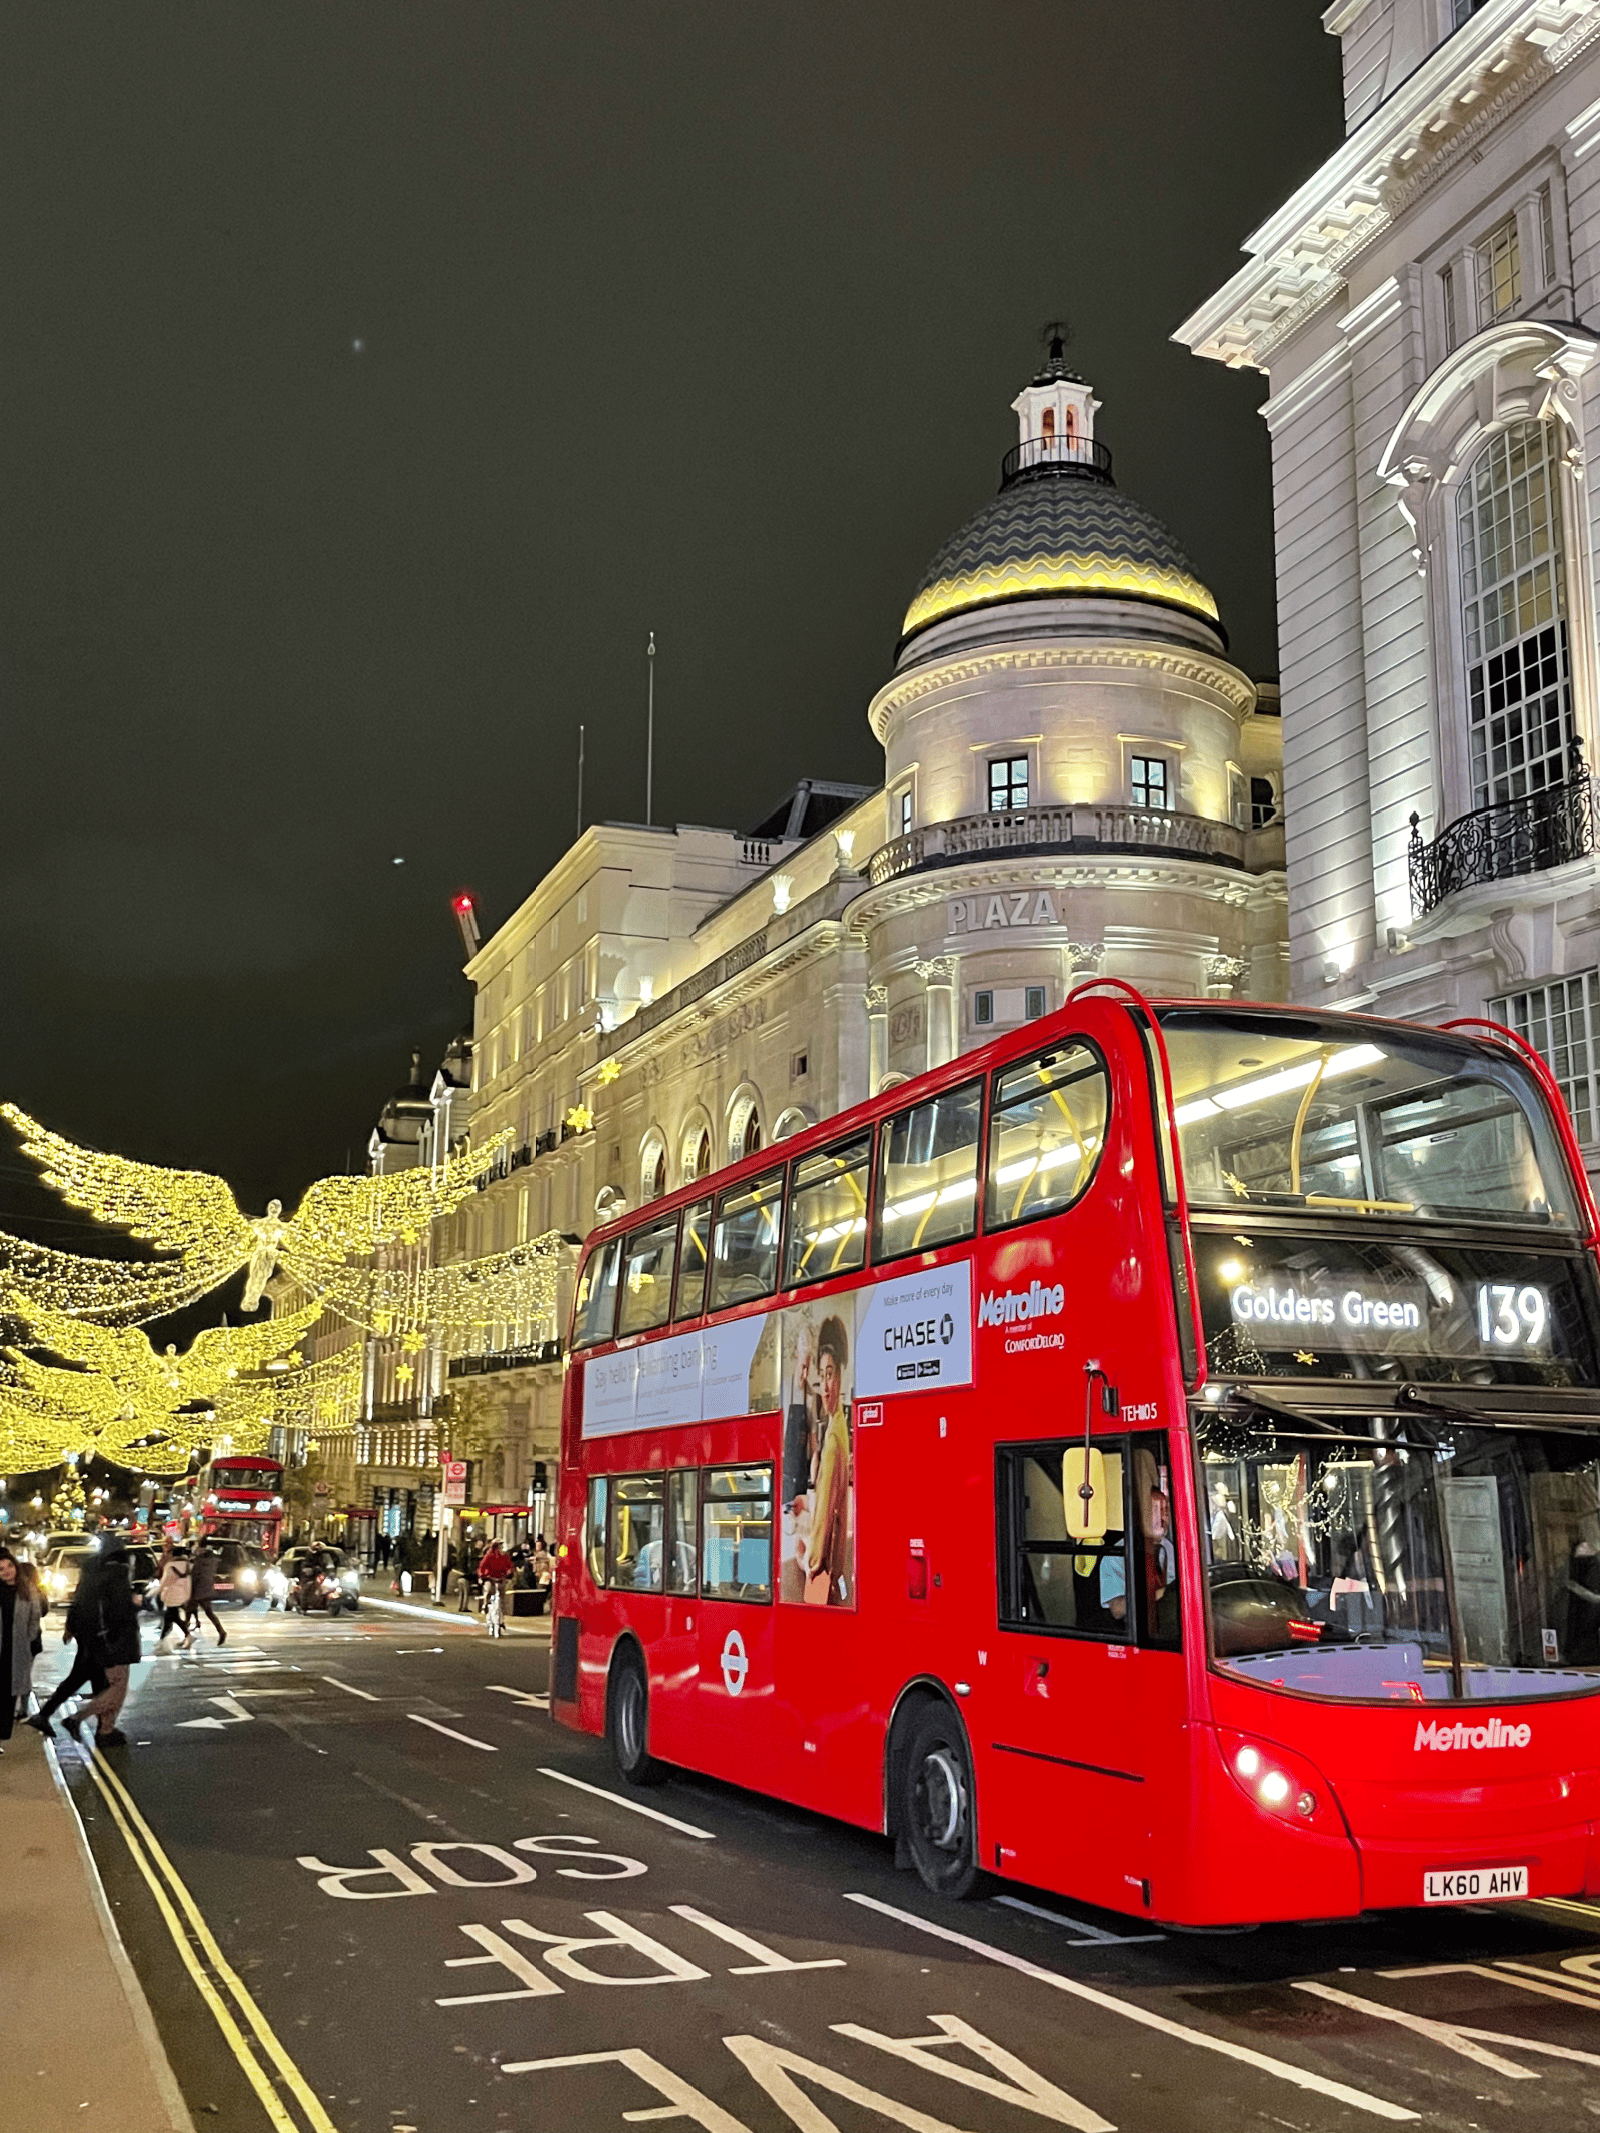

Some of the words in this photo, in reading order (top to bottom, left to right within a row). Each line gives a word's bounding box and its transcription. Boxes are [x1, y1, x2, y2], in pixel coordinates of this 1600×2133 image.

[948, 890, 1058, 935] PLAZA
[900, 1292, 915, 1304] more
[916, 1287, 922, 1300] of
[923, 1286, 940, 1299] every
[942, 1282, 953, 1296] day
[977, 1280, 1065, 1328] Metroline
[1232, 1286, 1335, 1323] Golders
[1343, 1291, 1420, 1327] Green
[1479, 1283, 1546, 1344] 139
[884, 1319, 936, 1352] CHASE
[1414, 1718, 1531, 1752] Metroline
[296, 1835, 648, 1900] SQR
[1429, 1874, 1480, 1897] LK60
[1488, 1870, 1522, 1894] AHV
[435, 1904, 847, 2007] TRF
